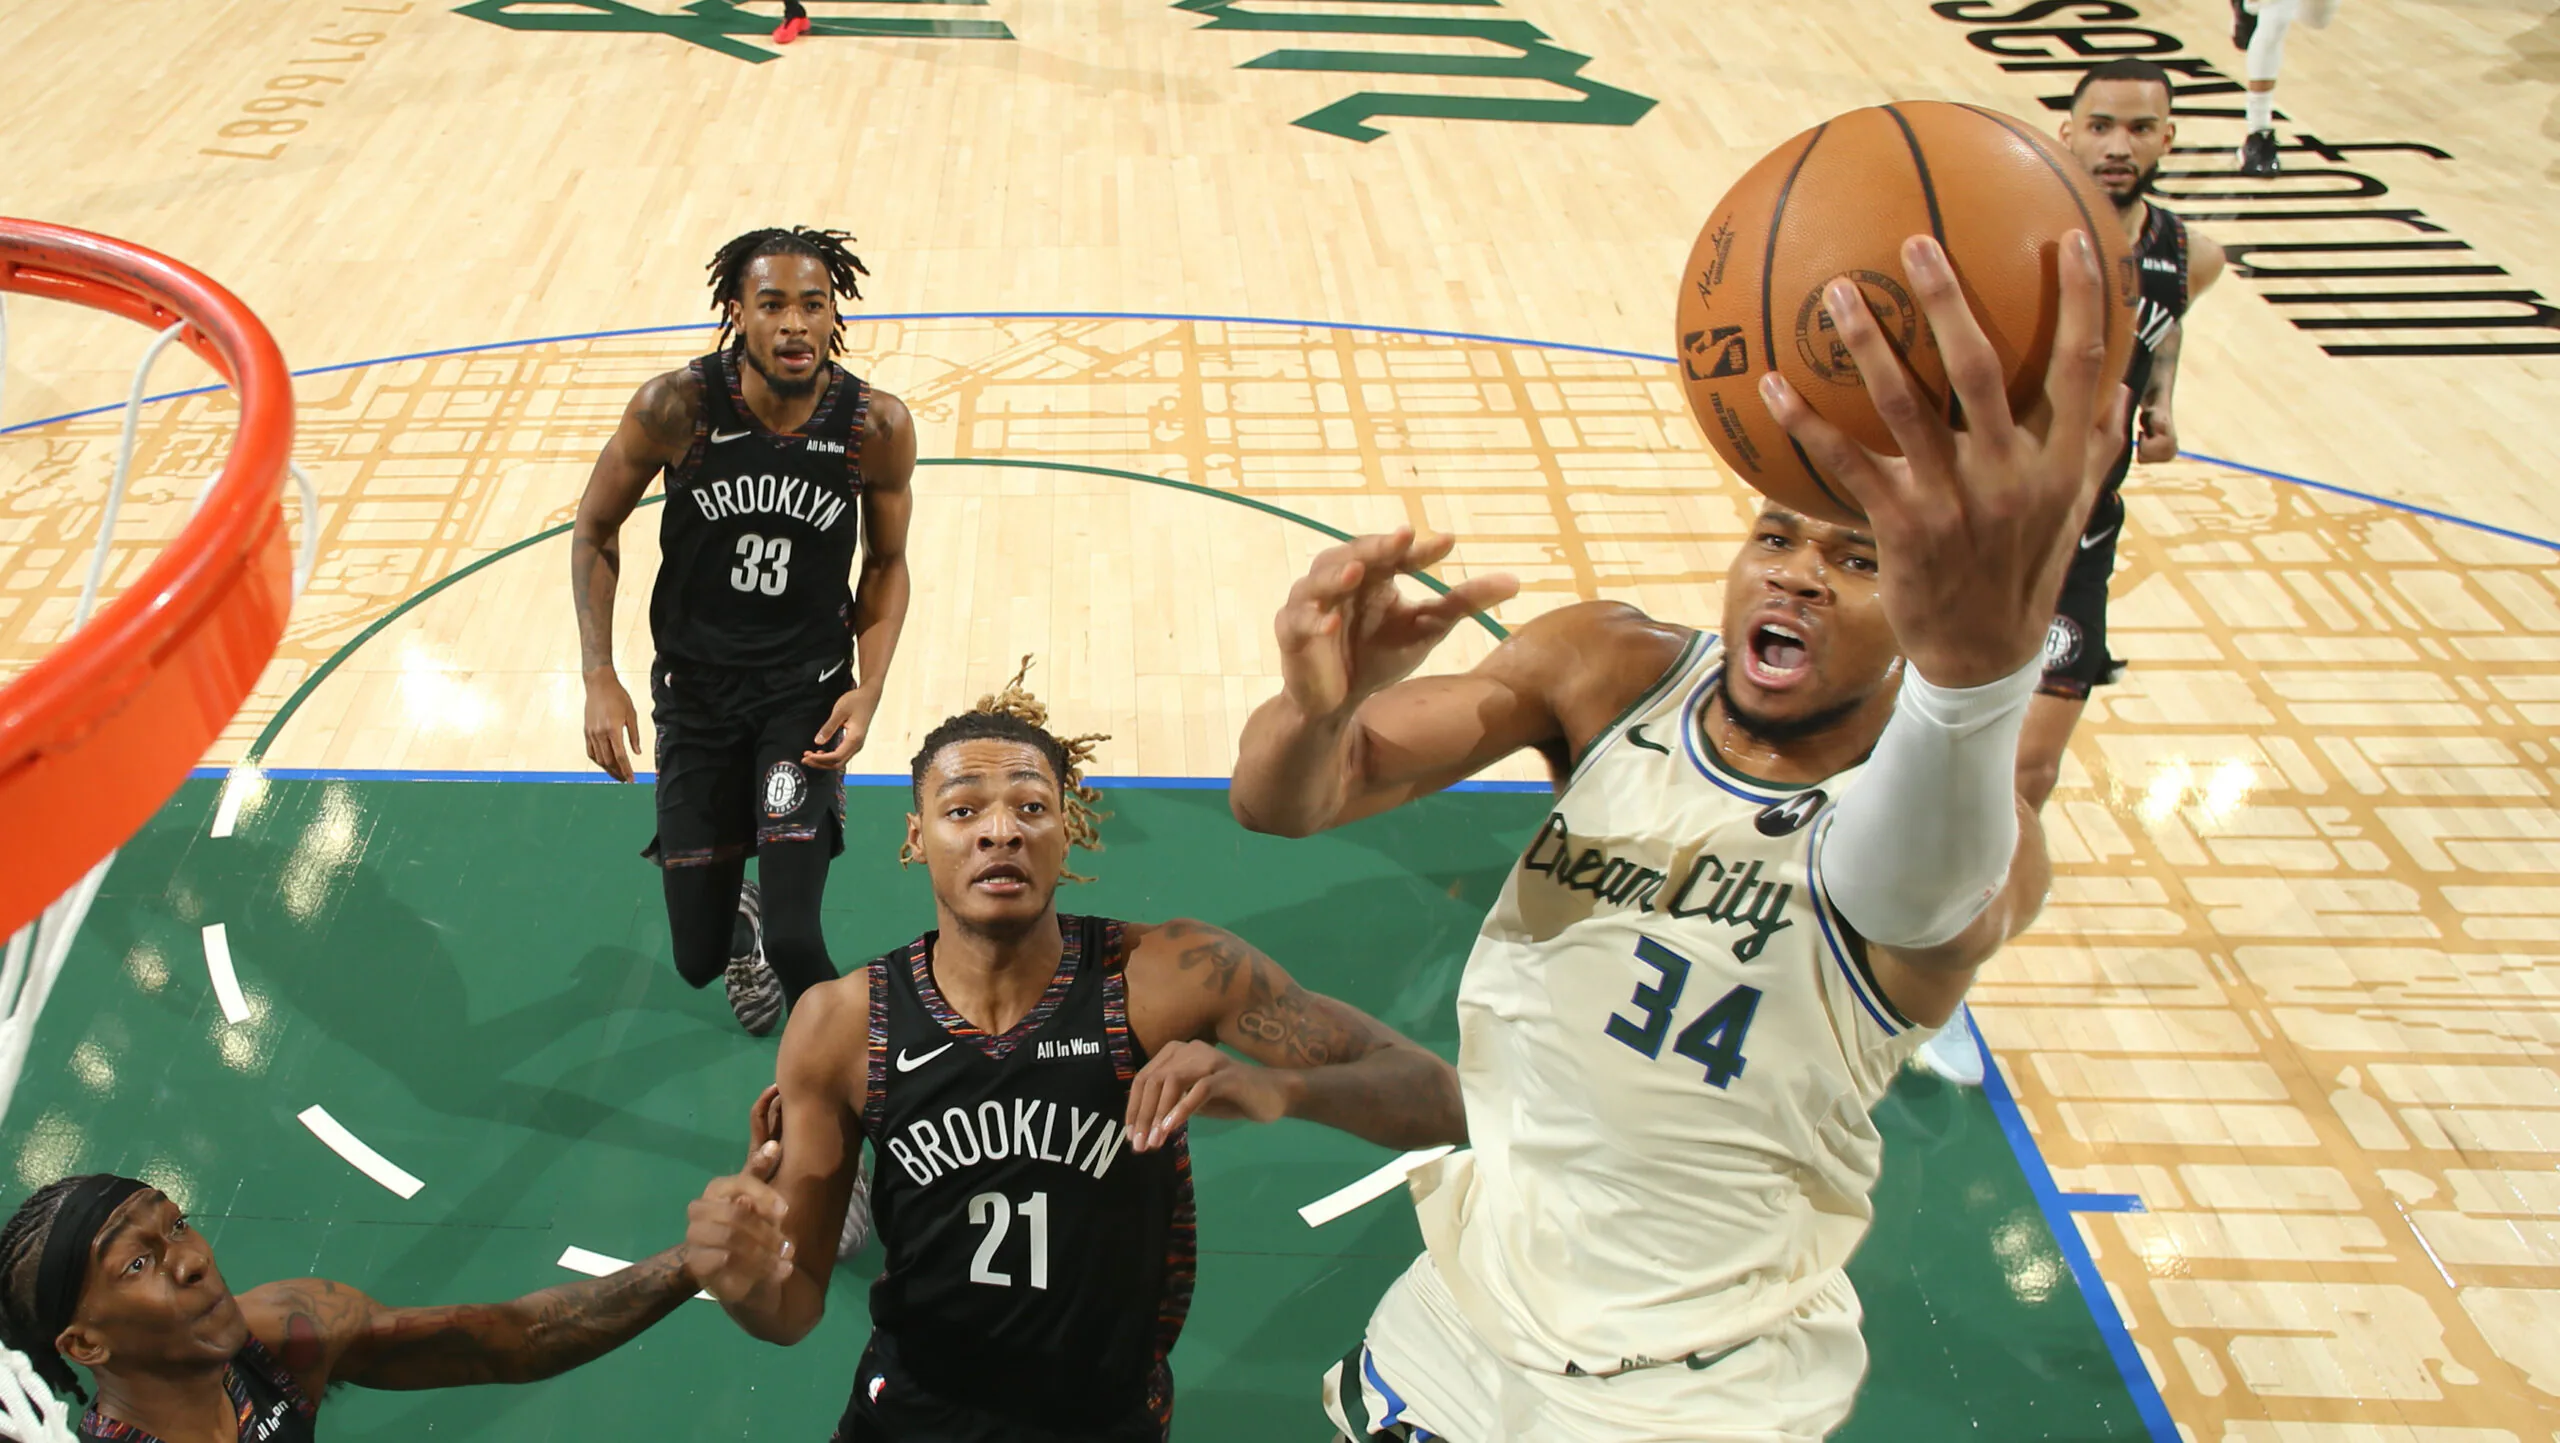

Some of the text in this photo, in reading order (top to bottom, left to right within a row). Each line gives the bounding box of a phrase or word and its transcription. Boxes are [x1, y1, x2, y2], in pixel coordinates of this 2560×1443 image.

[806, 439, 845, 454] All In Won
[692, 475, 847, 532] BROOKLYN
[730, 534, 792, 596] 33
[1525, 812, 1793, 963] Cream City
[1037, 1037, 1100, 1060] All In Won
[1603, 935, 1763, 1090] 34
[886, 1098, 1131, 1186] BROOKLYN
[968, 1191, 1048, 1290] 21
